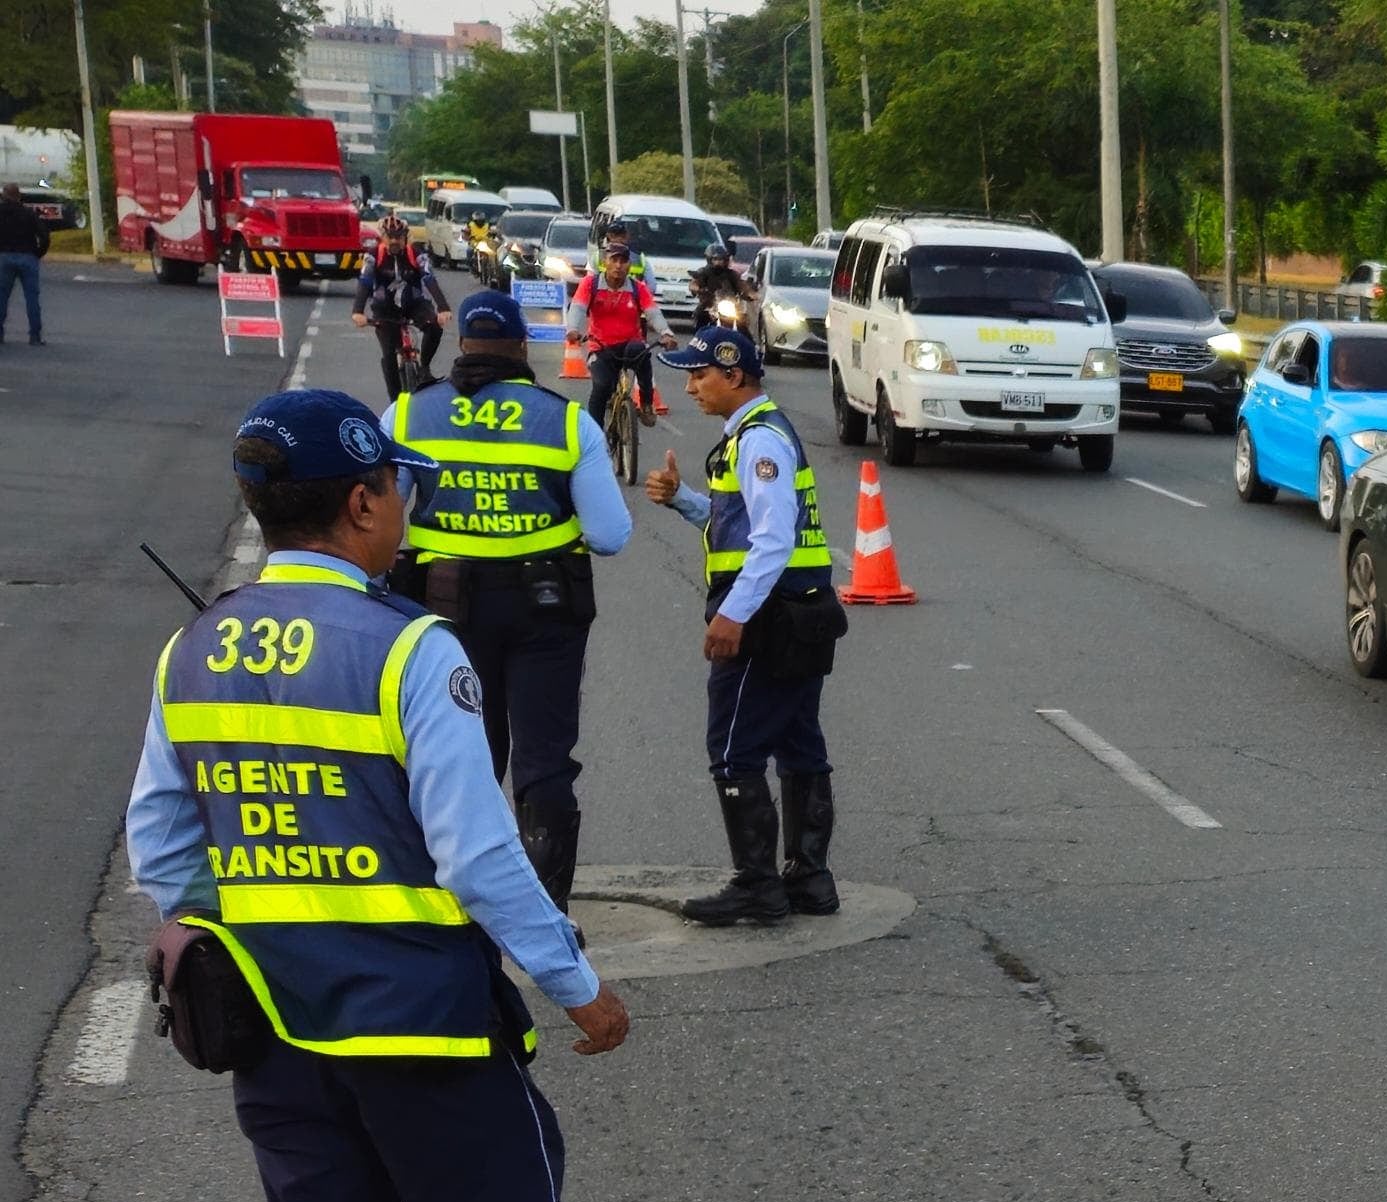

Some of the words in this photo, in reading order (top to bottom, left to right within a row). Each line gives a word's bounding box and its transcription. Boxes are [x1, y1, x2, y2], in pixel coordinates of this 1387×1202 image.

[450, 397, 523, 431] 342
[277, 426, 298, 447] CALI
[439, 470, 539, 490] AGENTE
[475, 493, 509, 512] DE
[435, 512, 552, 532] TRANSITO
[206, 617, 315, 675] 339
[196, 760, 347, 798] AGENTE
[240, 803, 300, 837] DE
